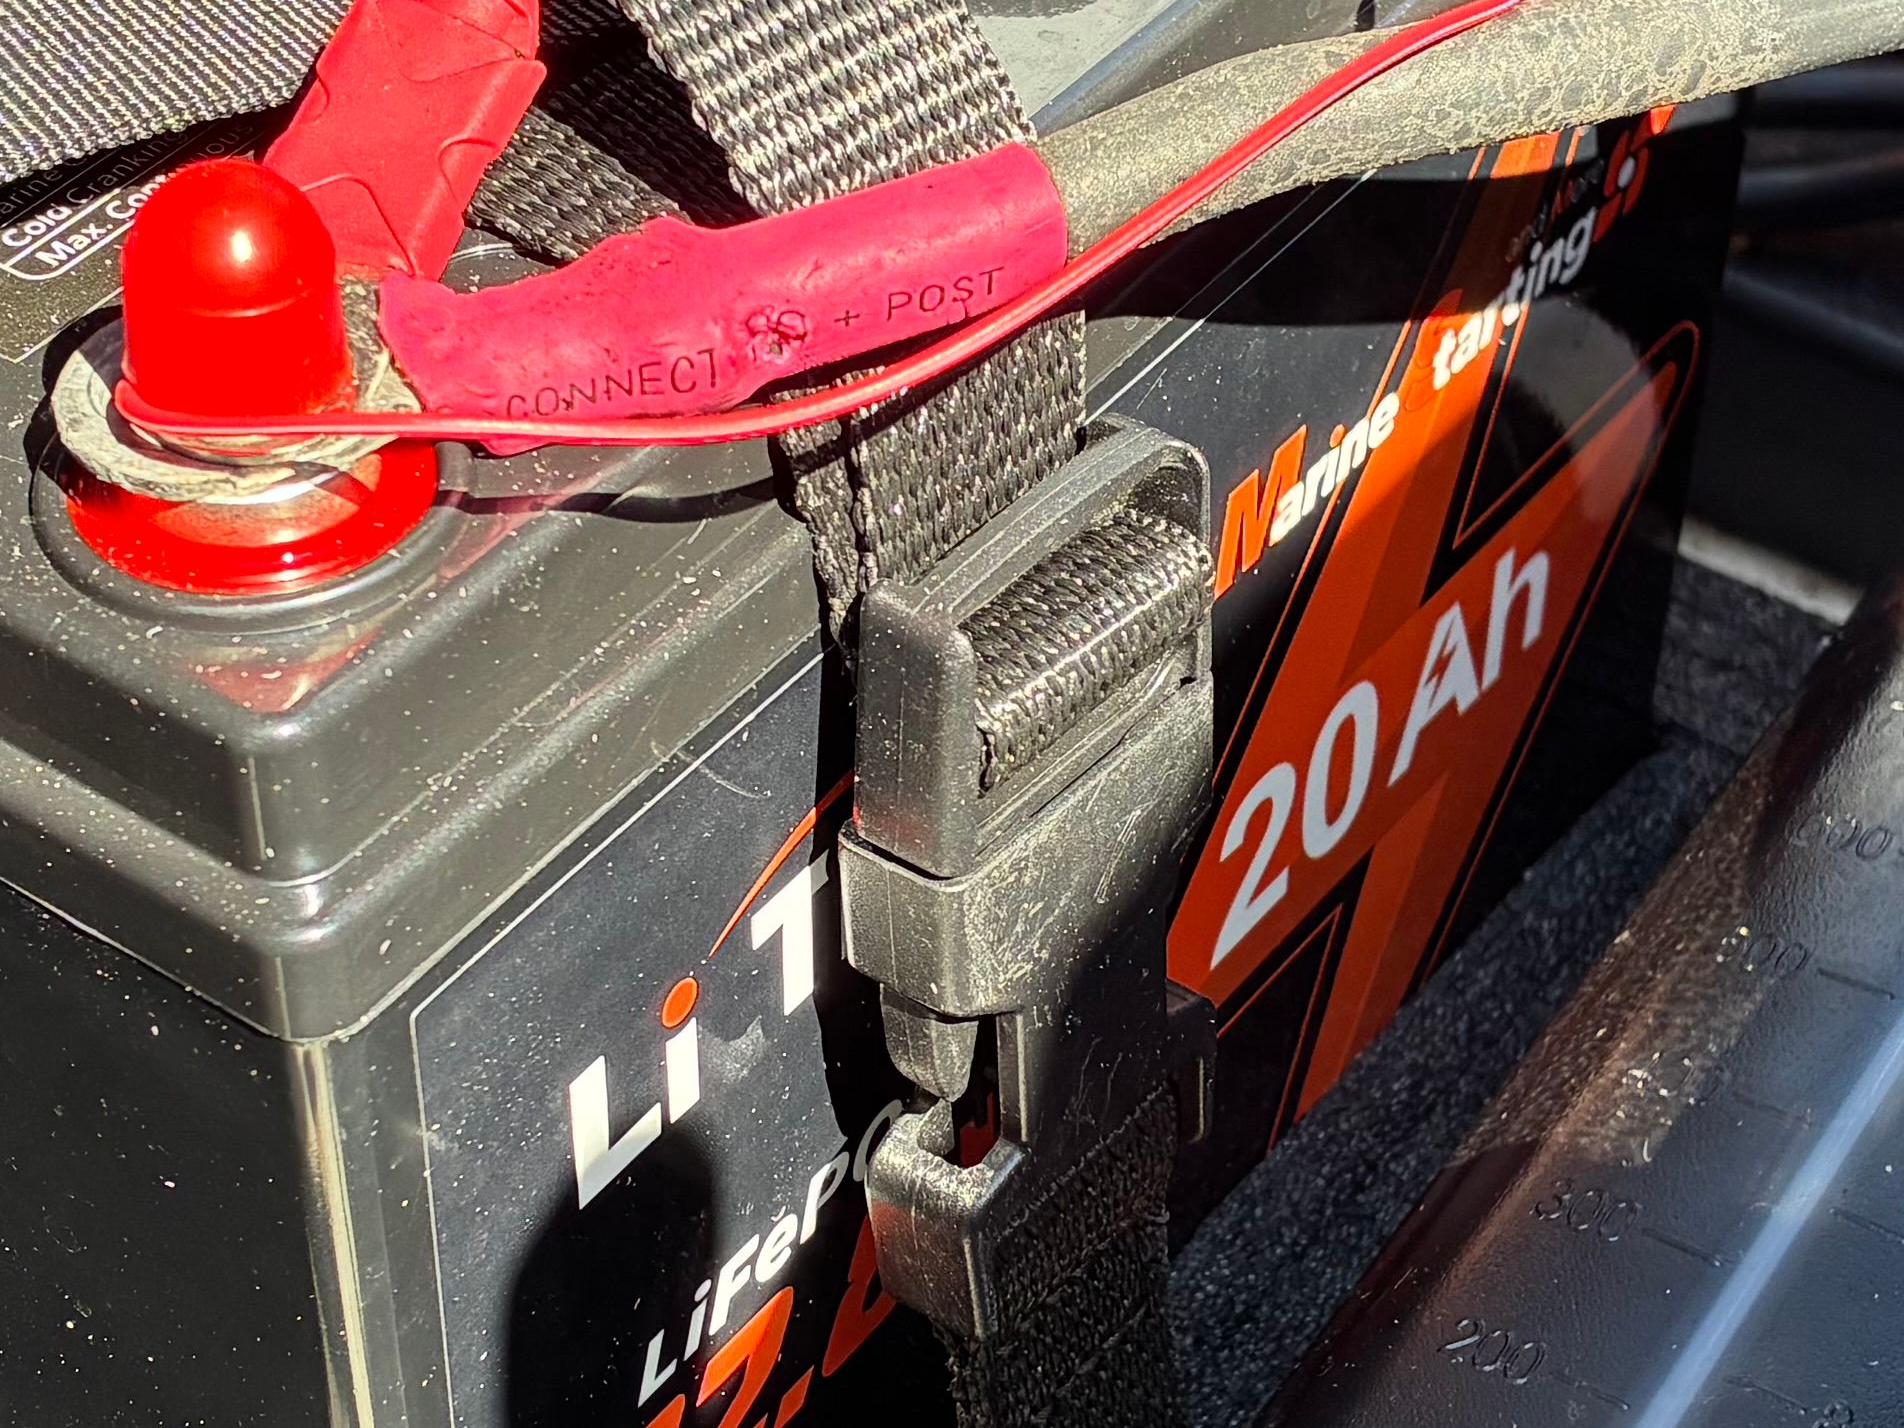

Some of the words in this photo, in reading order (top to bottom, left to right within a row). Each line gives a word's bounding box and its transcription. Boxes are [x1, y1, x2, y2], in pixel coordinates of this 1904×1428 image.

[1, 200, 73, 249] Cold
[66, 128, 190, 206] Cranking
[34, 221, 115, 269] Max.
[504, 347, 722, 419] CONNECT
[886, 267, 1008, 322] POST
[1214, 391, 1400, 594] Marine
[1209, 679, 1380, 972] 20
[1386, 545, 1550, 789] Ah
[568, 975, 701, 1211] Li
